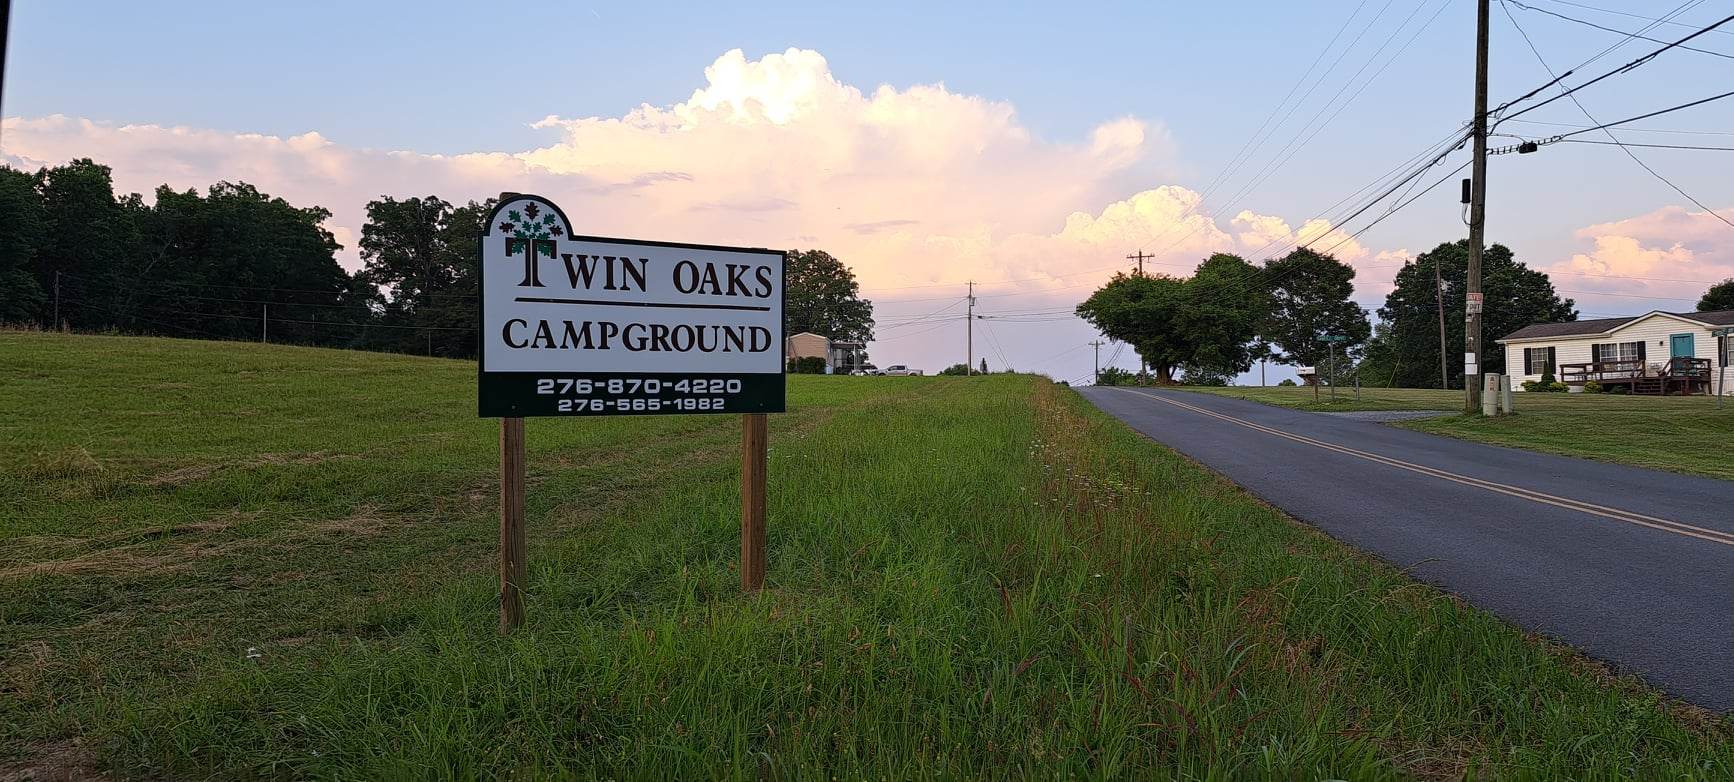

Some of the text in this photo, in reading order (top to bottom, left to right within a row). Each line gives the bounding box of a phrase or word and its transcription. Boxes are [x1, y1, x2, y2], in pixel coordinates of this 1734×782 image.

[505, 237, 773, 299] TWIN OAKS
[502, 318, 772, 353] CAMPGROUND
[537, 379, 742, 395] 276-870-4220
[558, 398, 725, 412] 276-565-1982
